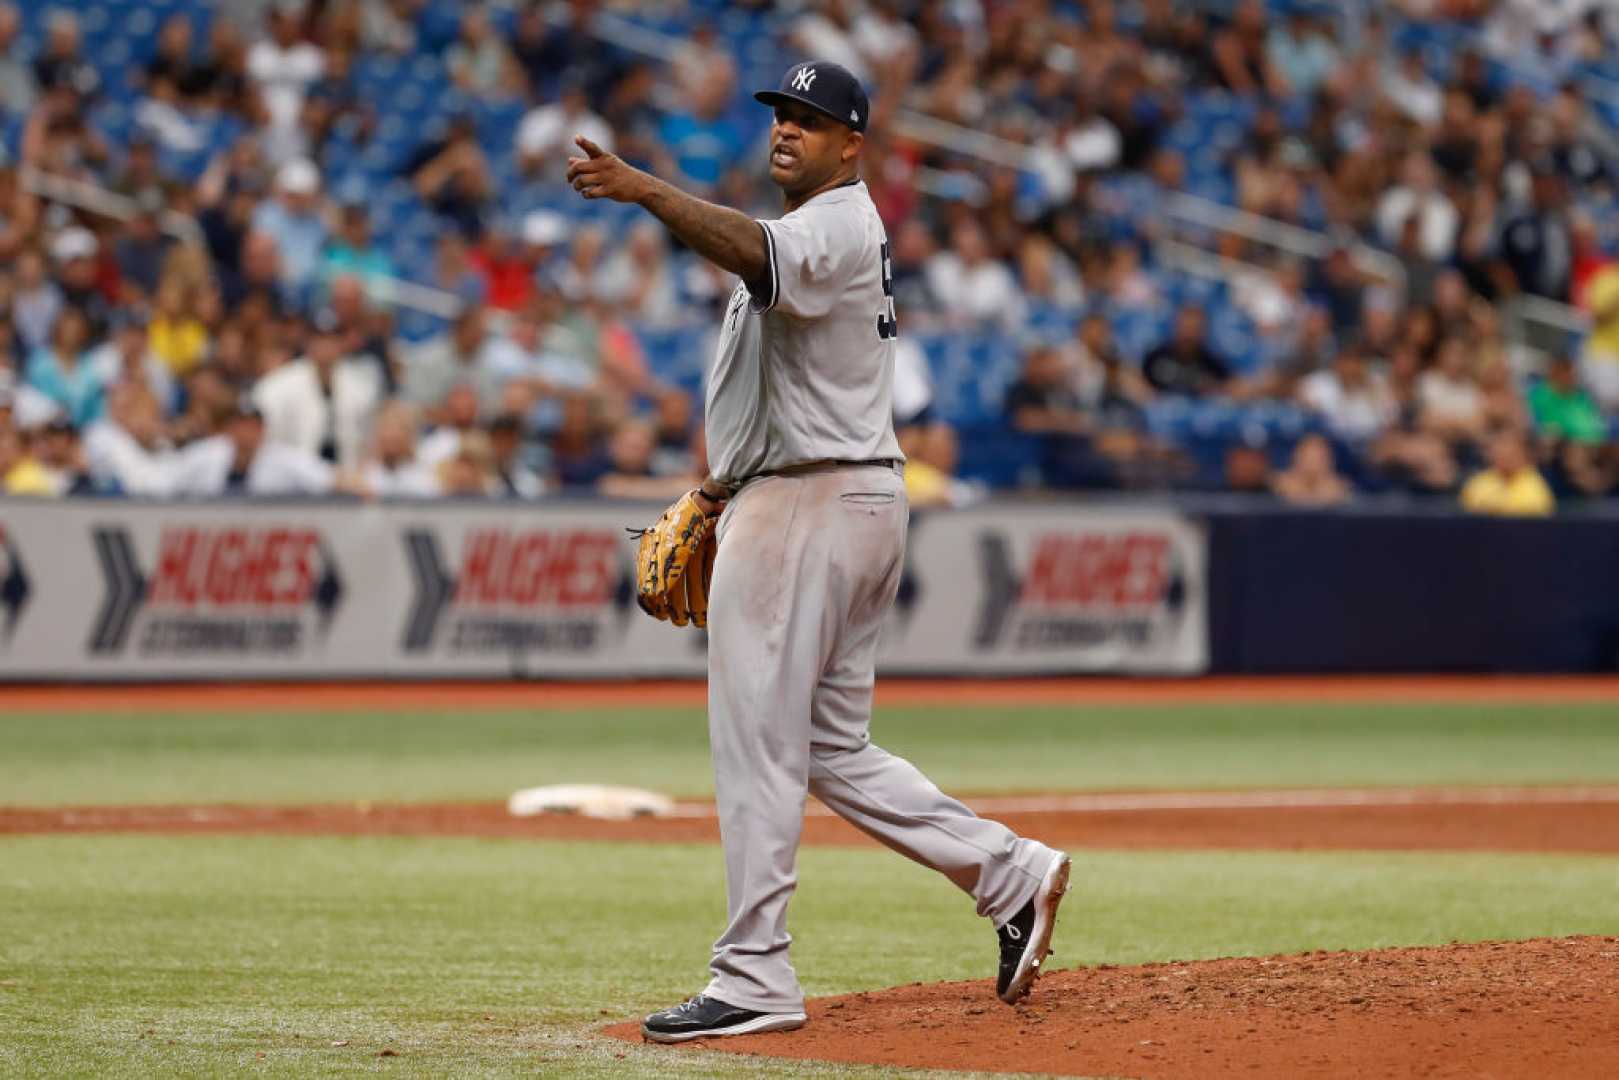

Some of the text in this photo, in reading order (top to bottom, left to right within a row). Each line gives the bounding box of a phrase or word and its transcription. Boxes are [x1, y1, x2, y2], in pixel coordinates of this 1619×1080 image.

[791, 67, 816, 91] NY
[148, 528, 317, 606] HUGHES
[455, 530, 616, 606] HUGHES
